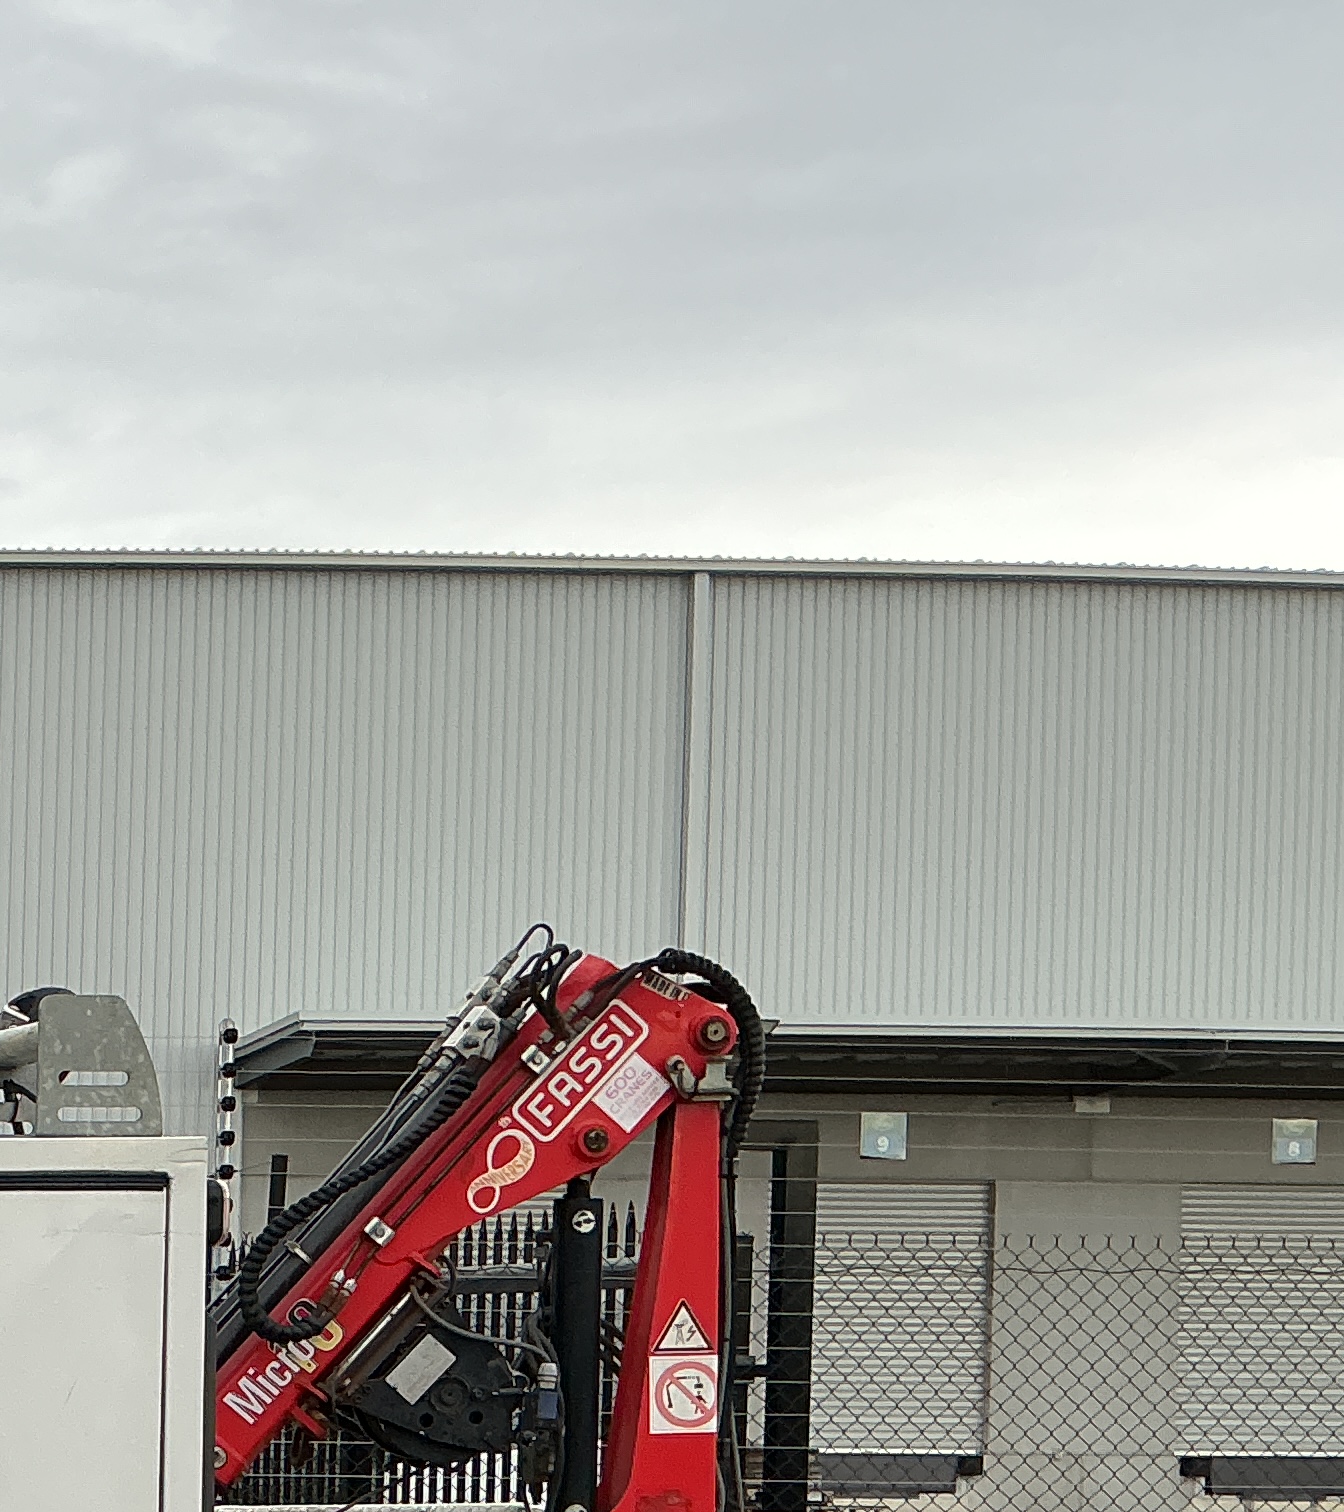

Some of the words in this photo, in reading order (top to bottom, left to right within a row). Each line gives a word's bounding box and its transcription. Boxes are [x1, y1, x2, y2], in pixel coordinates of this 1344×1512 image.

[526, 1013, 635, 1128] FASSI
[609, 1070, 653, 1115] CRANES
[877, 1135, 889, 1152] 9
[1288, 1141, 1301, 1157] 8
[470, 1140, 534, 1194] ANNIVERSARY
